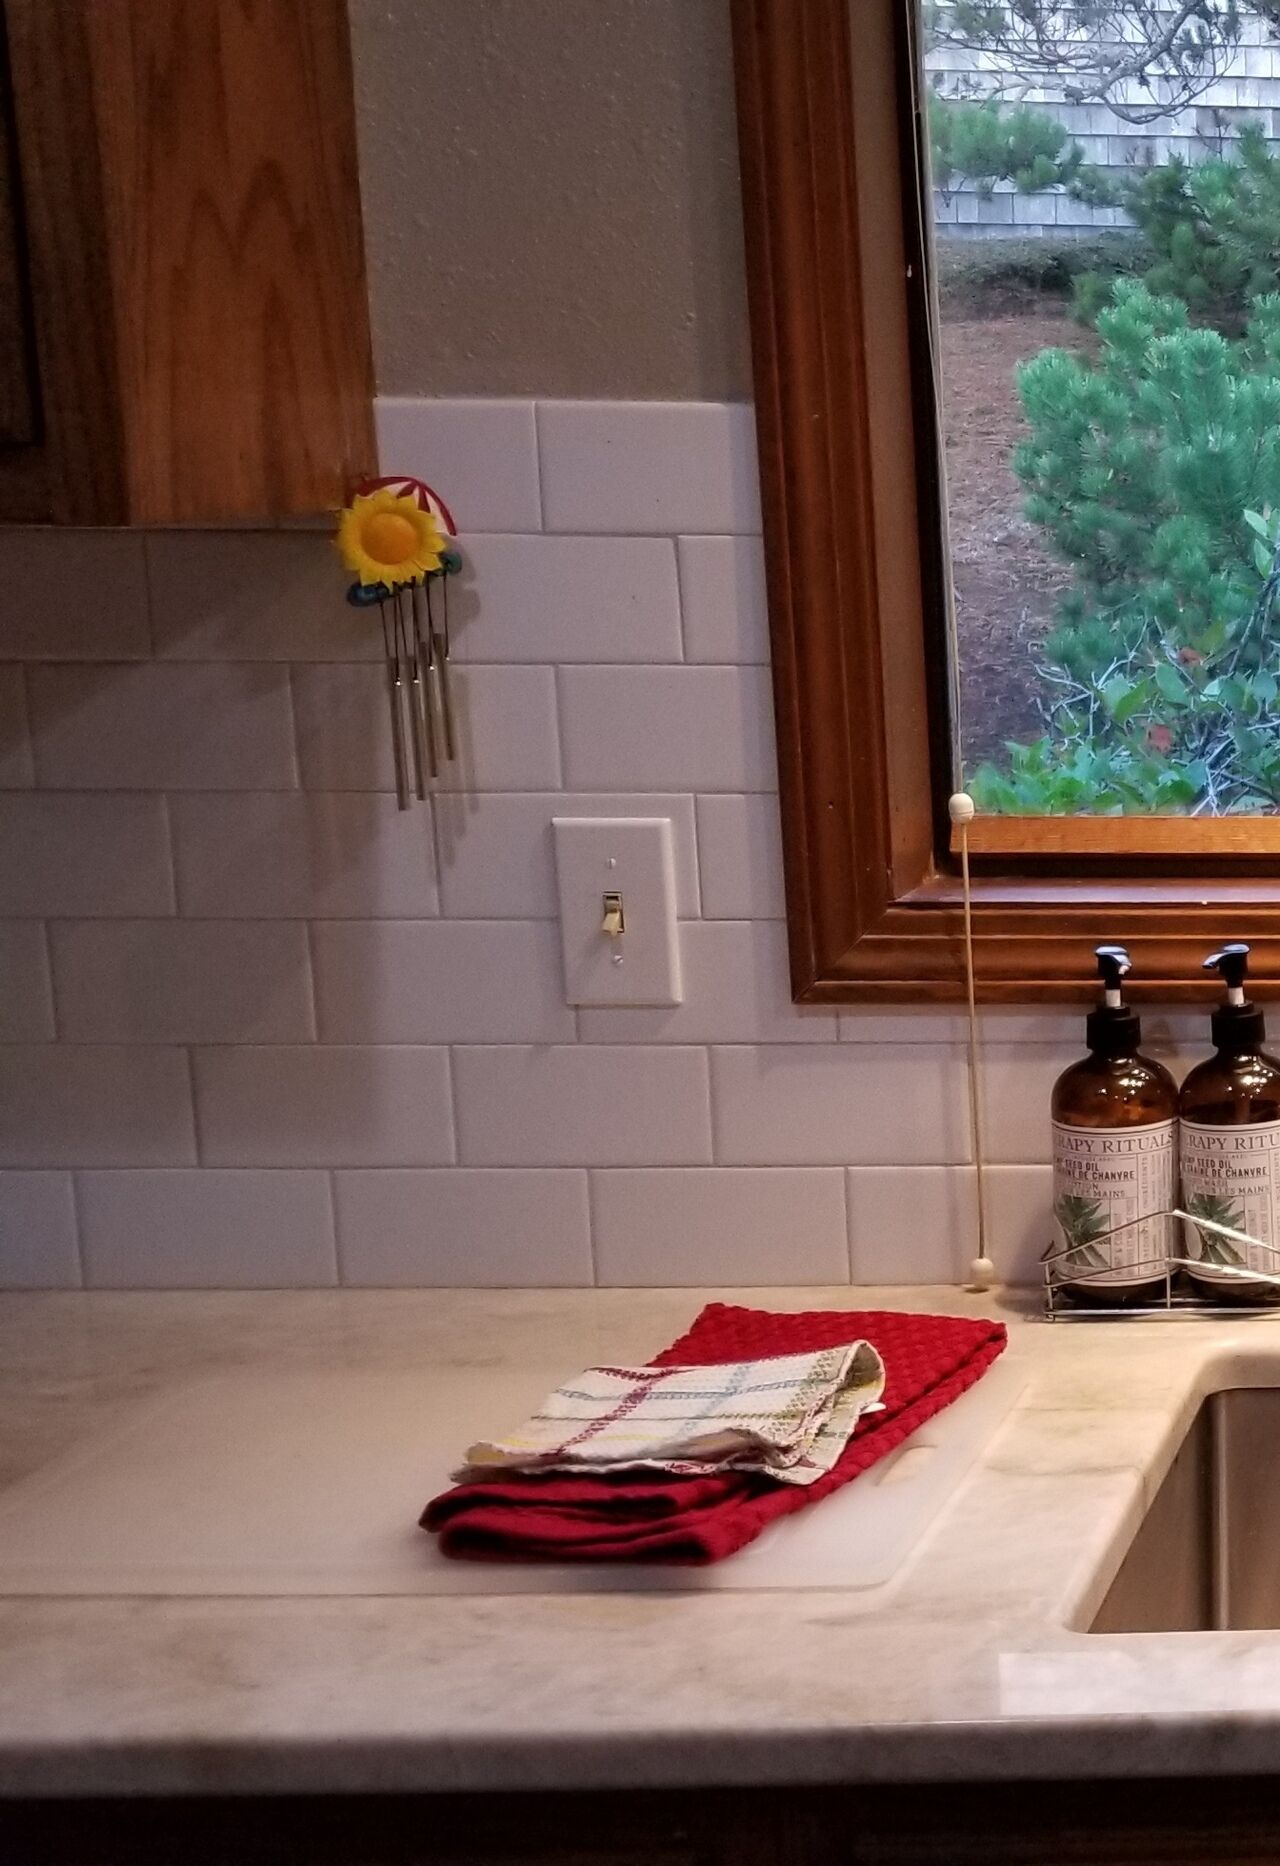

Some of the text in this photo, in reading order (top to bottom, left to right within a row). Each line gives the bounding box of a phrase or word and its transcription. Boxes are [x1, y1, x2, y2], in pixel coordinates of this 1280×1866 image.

[1102, 1132, 1173, 1153] RITUALS
[1186, 1134, 1227, 1150] RAPY
[1085, 1161, 1099, 1171] OIL
[1219, 1160, 1232, 1169] OIL
[1092, 1170, 1135, 1180] CHANVRE
[1211, 1168, 1222, 1178] DE
[1225, 1166, 1267, 1178] CHANVRE
